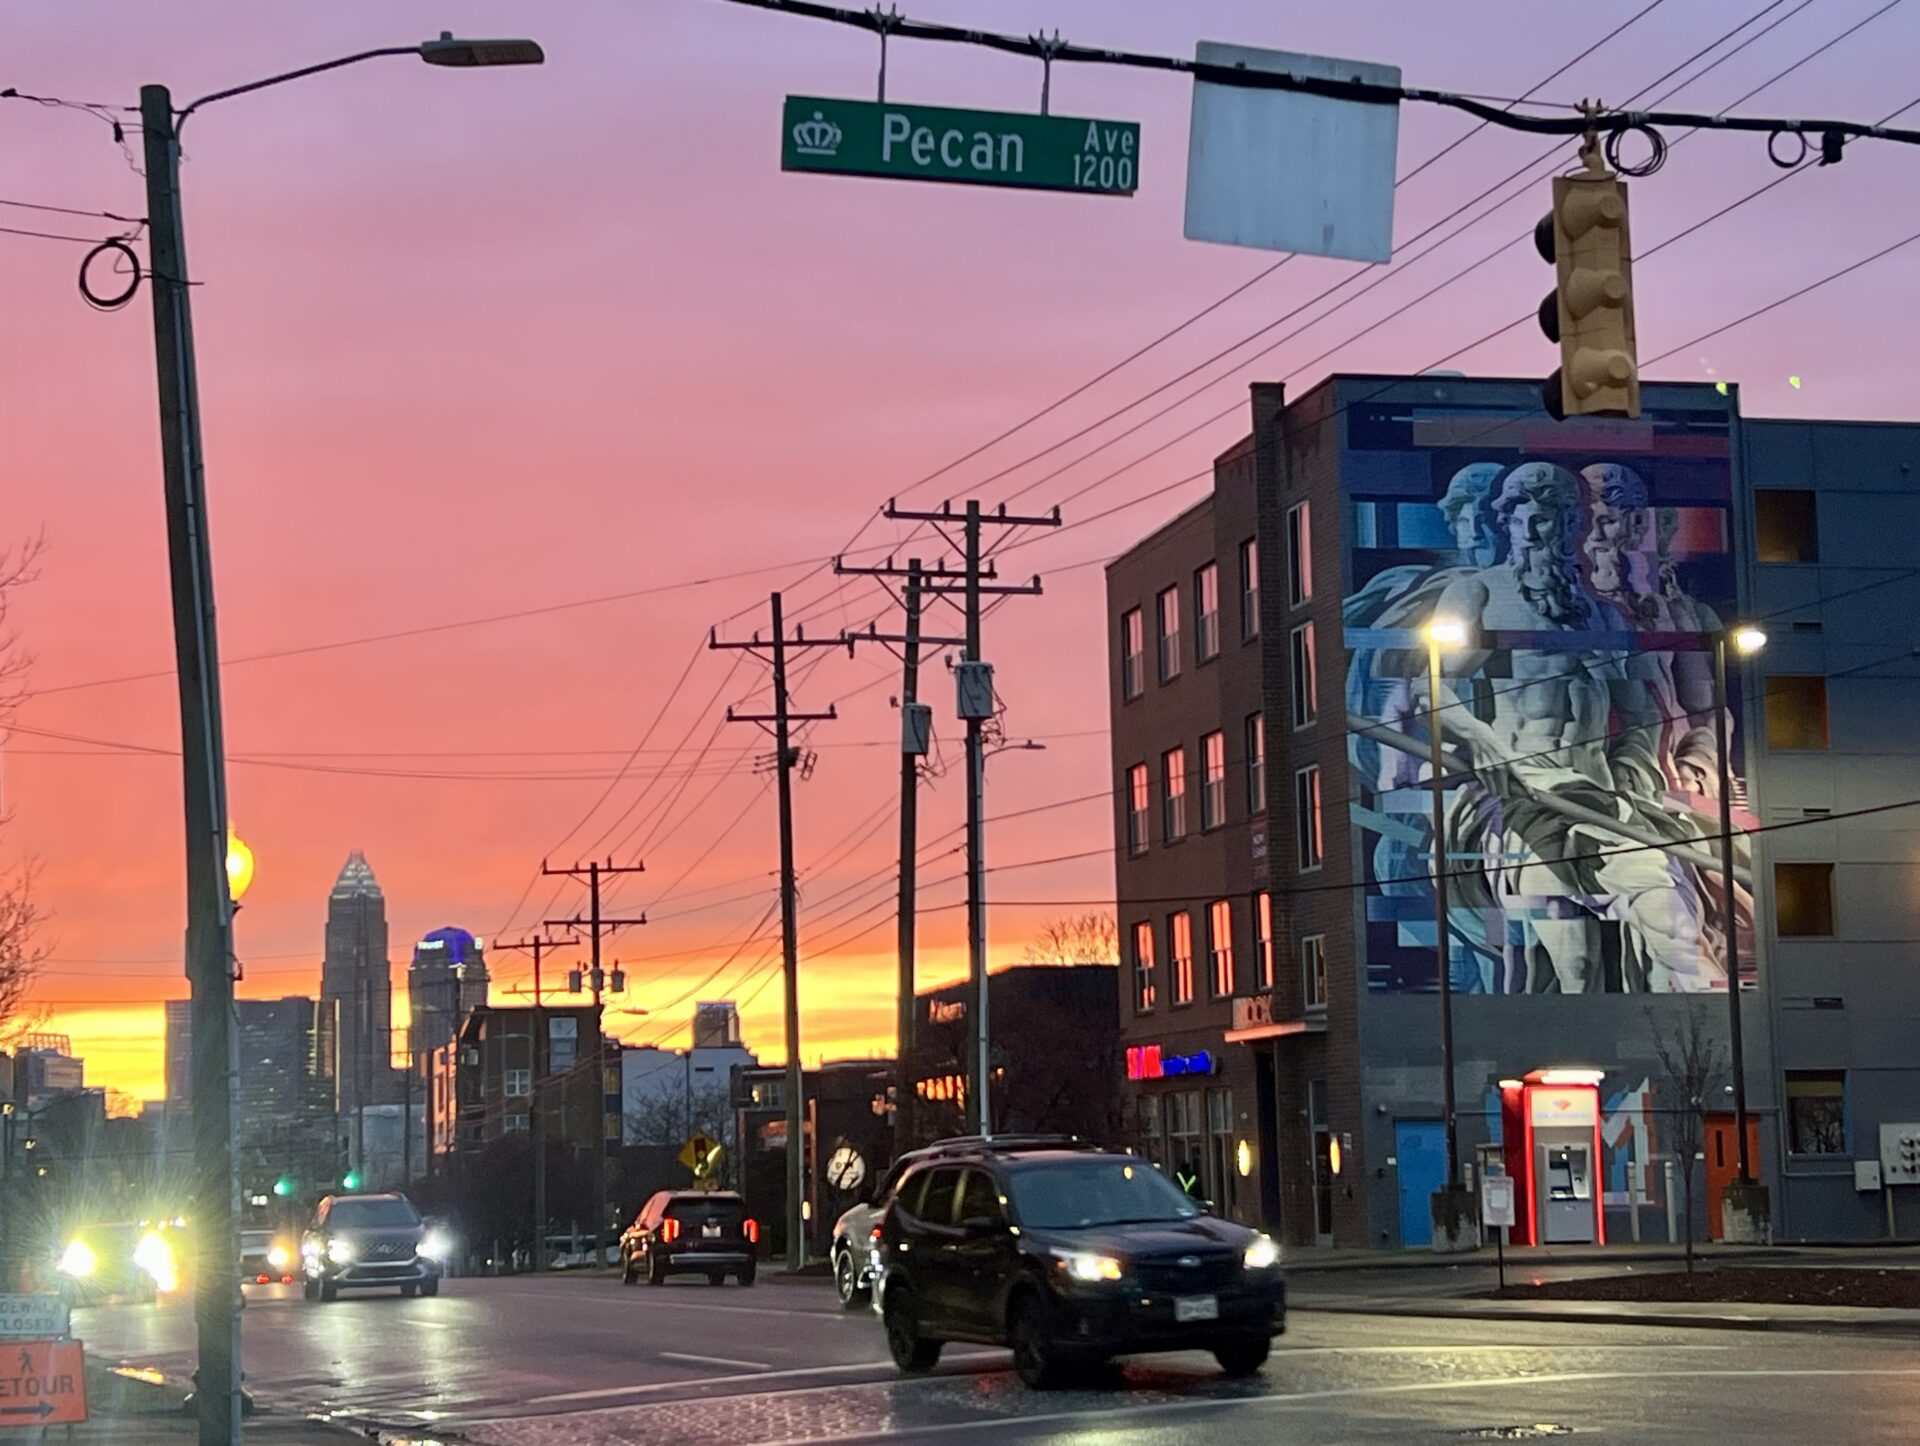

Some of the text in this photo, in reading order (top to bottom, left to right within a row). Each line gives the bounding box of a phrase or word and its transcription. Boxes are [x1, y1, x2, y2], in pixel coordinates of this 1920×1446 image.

[882, 113, 1024, 173] Pecan
[1084, 121, 1134, 155] Ave
[1073, 153, 1132, 189] 1200
